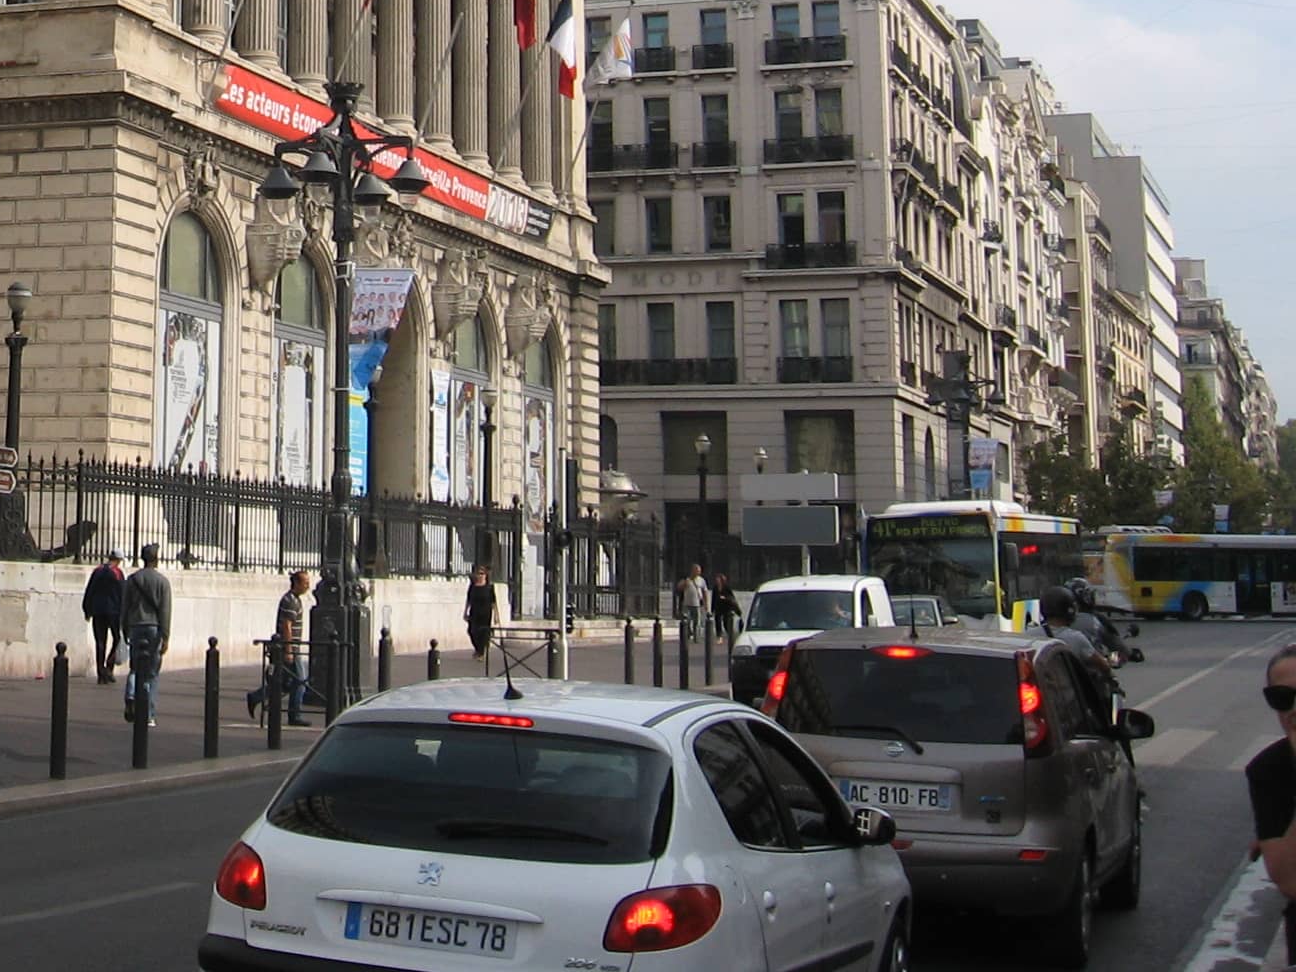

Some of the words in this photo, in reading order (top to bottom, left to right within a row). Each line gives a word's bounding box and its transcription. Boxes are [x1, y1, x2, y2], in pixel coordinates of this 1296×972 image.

[220, 76, 244, 105] Les
[246, 89, 291, 125] acteurs
[451, 175, 488, 209] Provence
